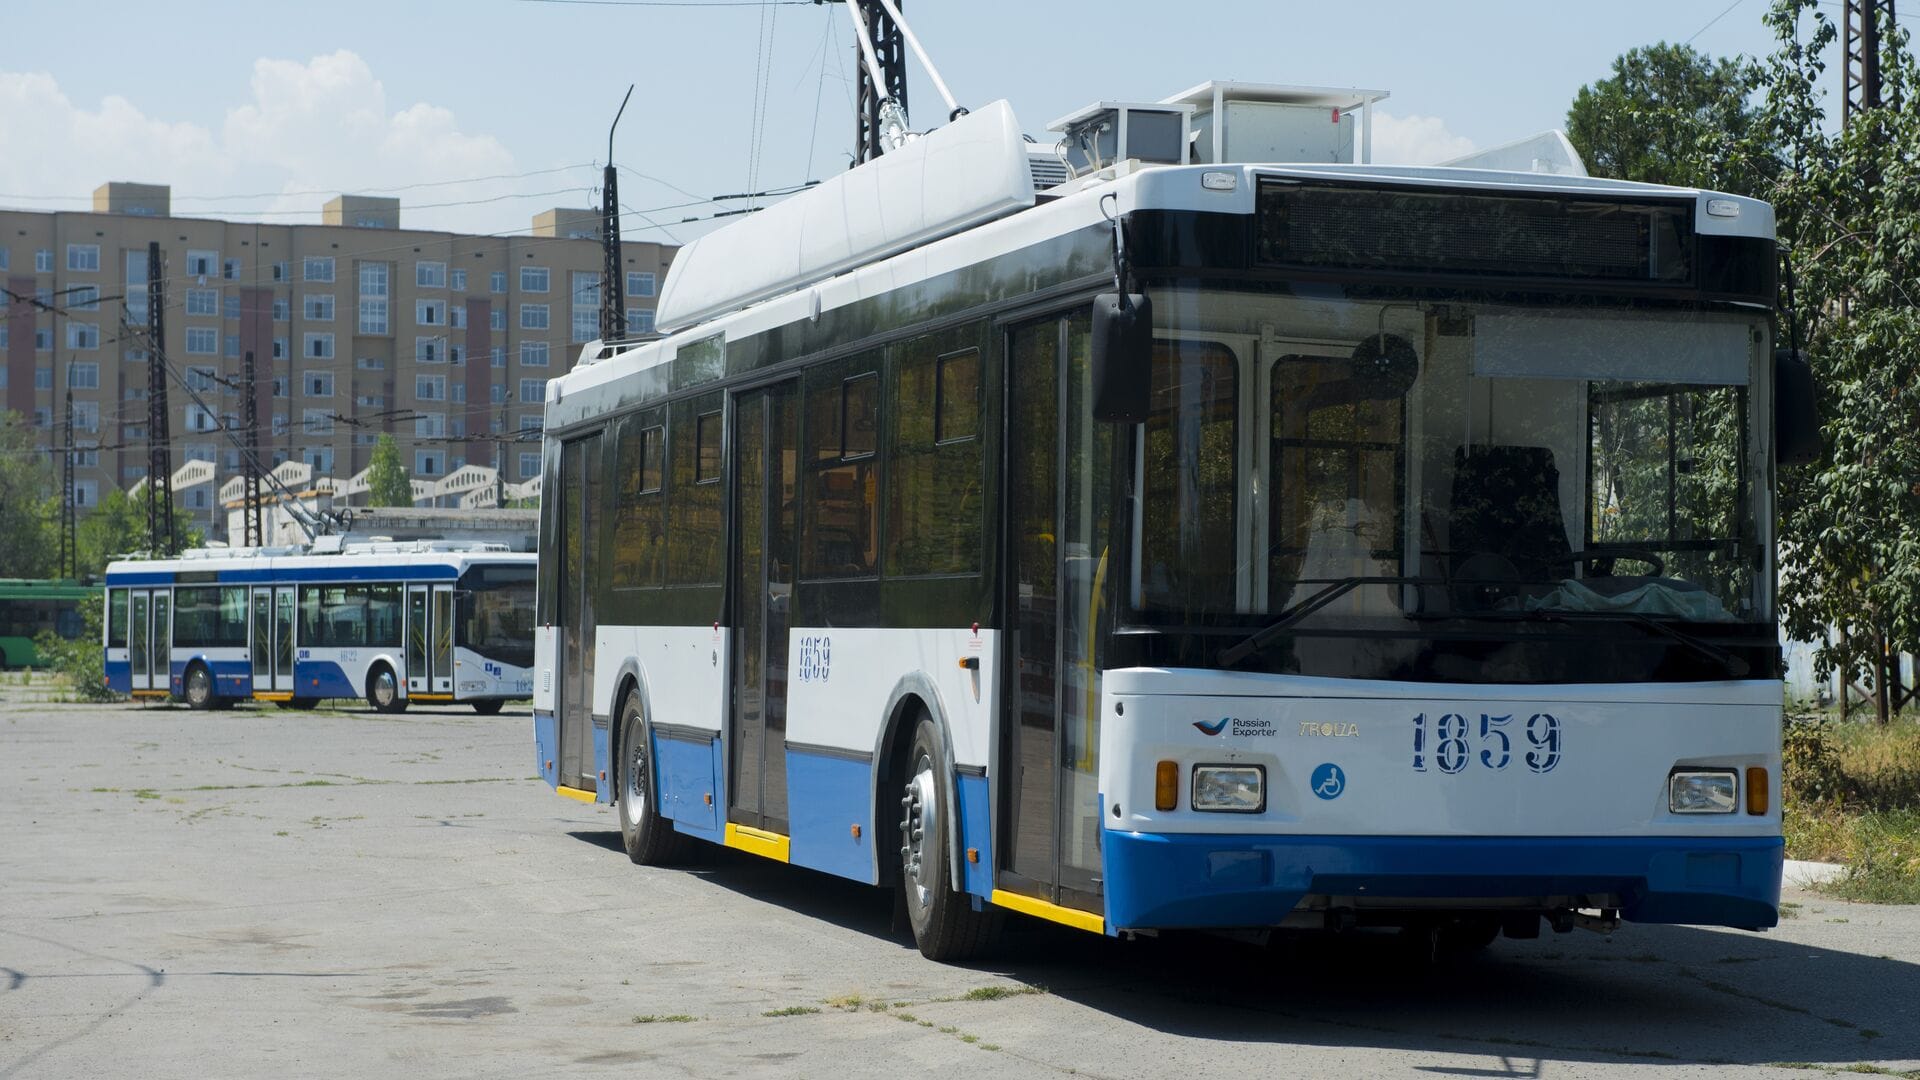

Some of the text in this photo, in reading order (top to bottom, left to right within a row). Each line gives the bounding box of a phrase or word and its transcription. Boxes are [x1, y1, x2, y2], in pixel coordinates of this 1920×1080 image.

[799, 636, 830, 683] 1859
[1232, 718, 1271, 728] Russian
[1299, 721, 1360, 737] TROLZA
[1232, 728, 1278, 737] Exporter
[1412, 712, 1562, 774] 1859
